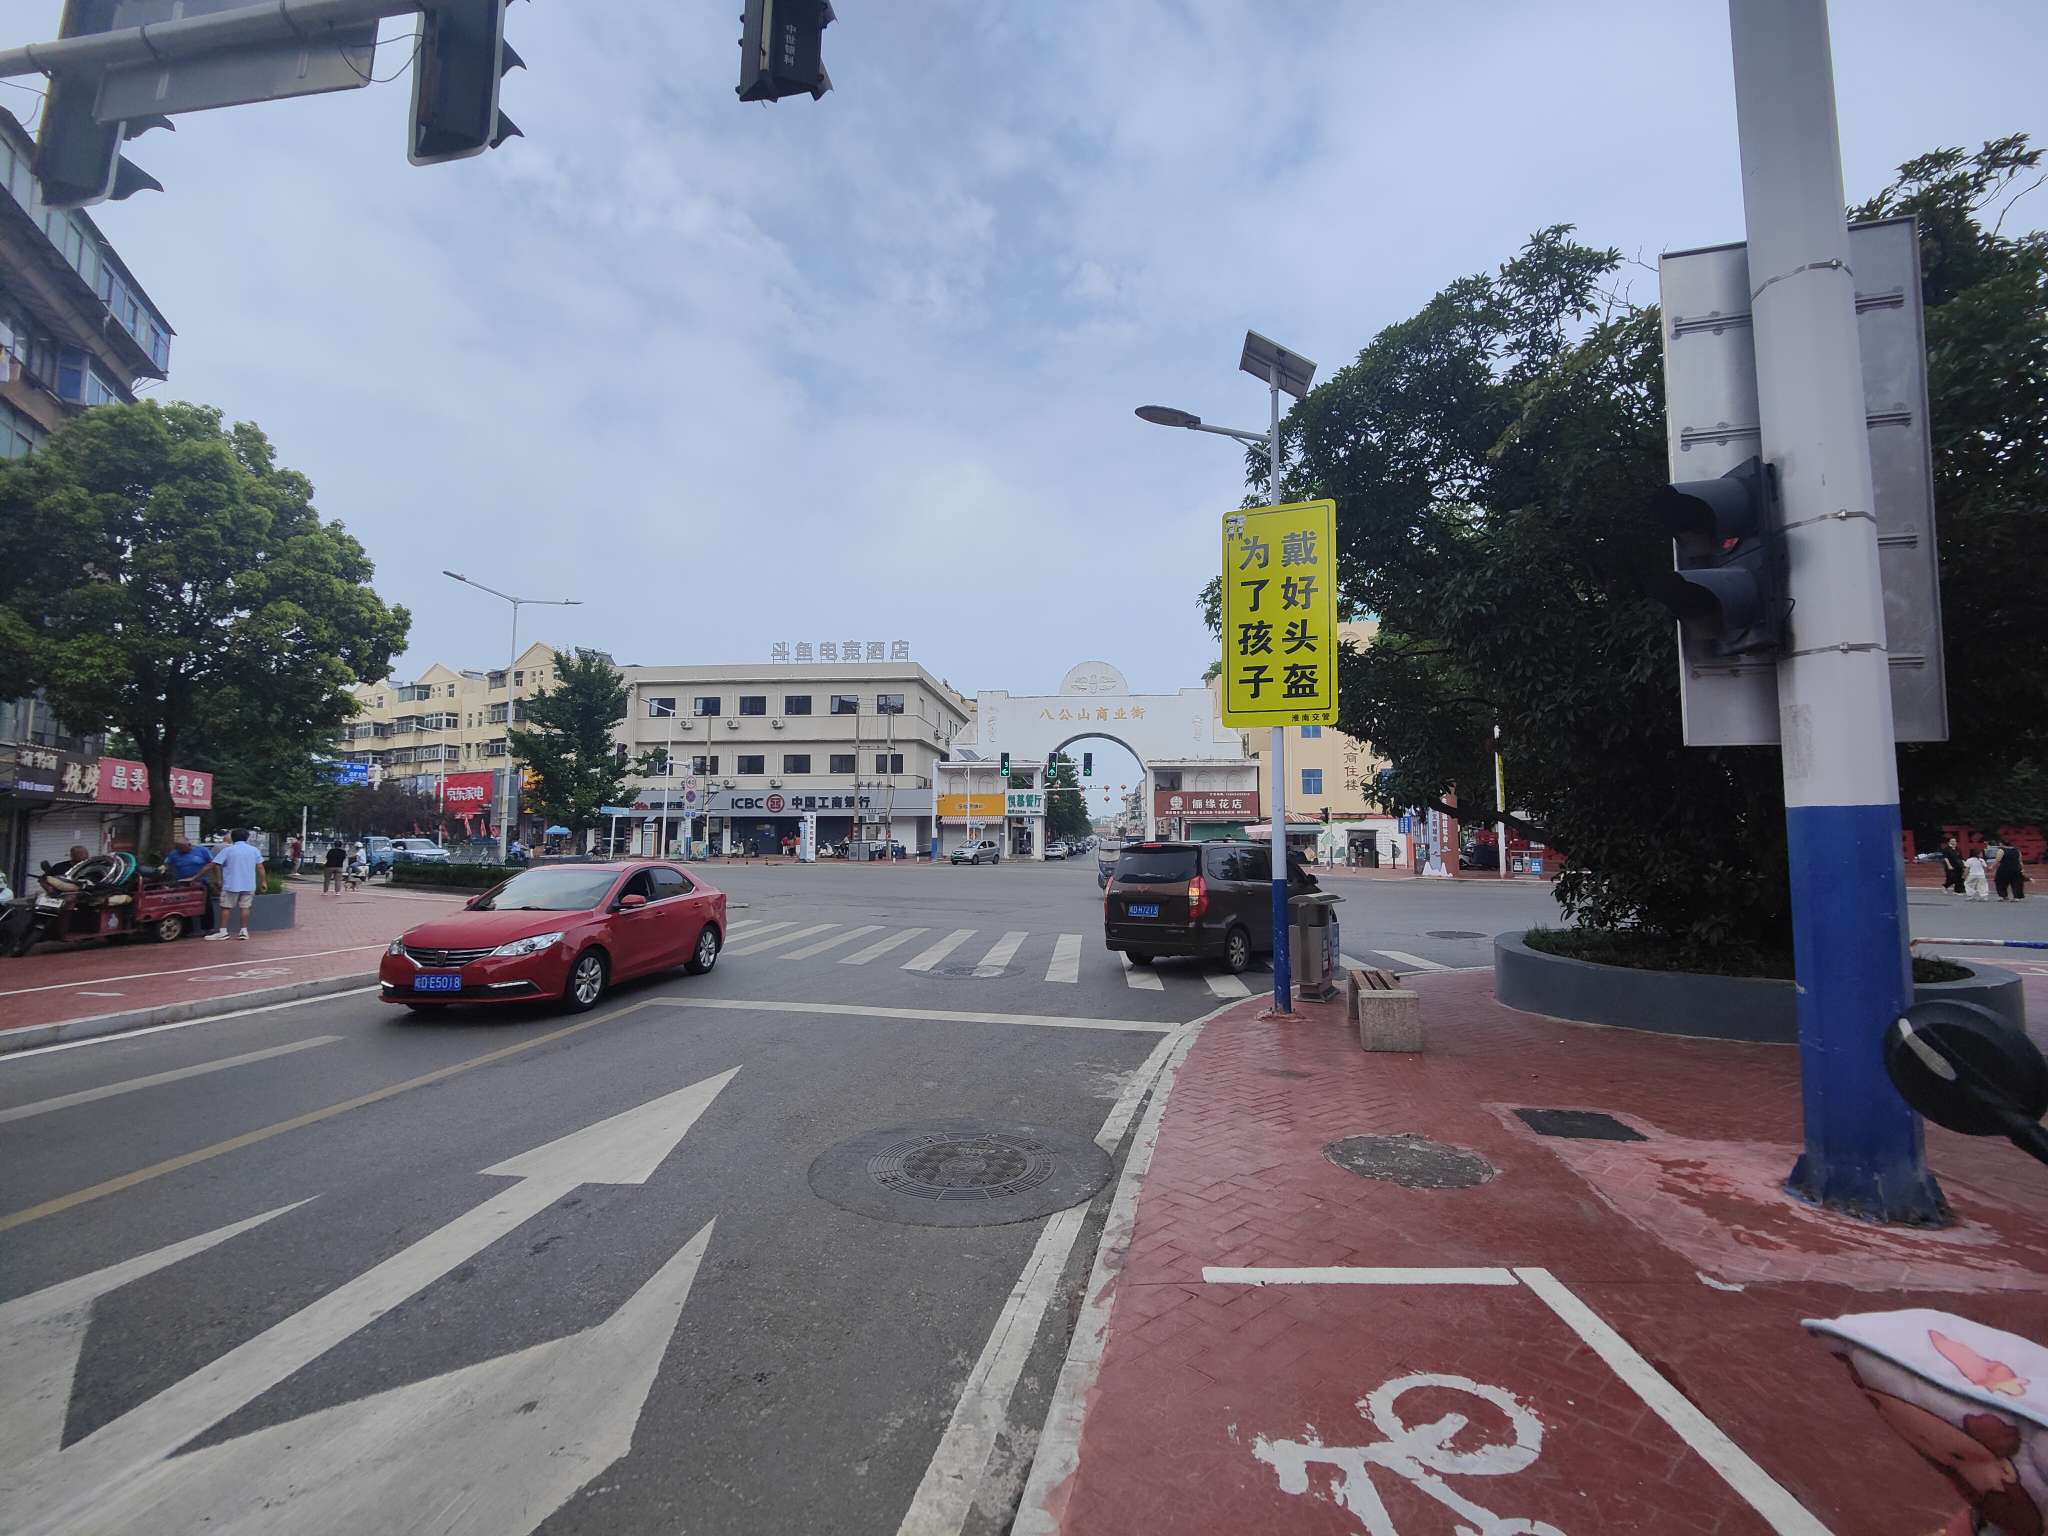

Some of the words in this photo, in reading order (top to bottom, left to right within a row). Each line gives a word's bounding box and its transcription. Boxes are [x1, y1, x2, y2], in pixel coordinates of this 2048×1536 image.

[1238, 535, 1273, 699] 为了孩子
[1281, 530, 1319, 699] 戴好头盔
[771, 640, 910, 661] 斗鱼电竞酒店
[1040, 707, 1146, 721] 八公山商业街
[1291, 713, 1330, 722] 淮南交管
[731, 797, 764, 809] ICBC
[791, 795, 871, 809] 中国工商银行
[1192, 799, 1243, 809] 俪缘花店
